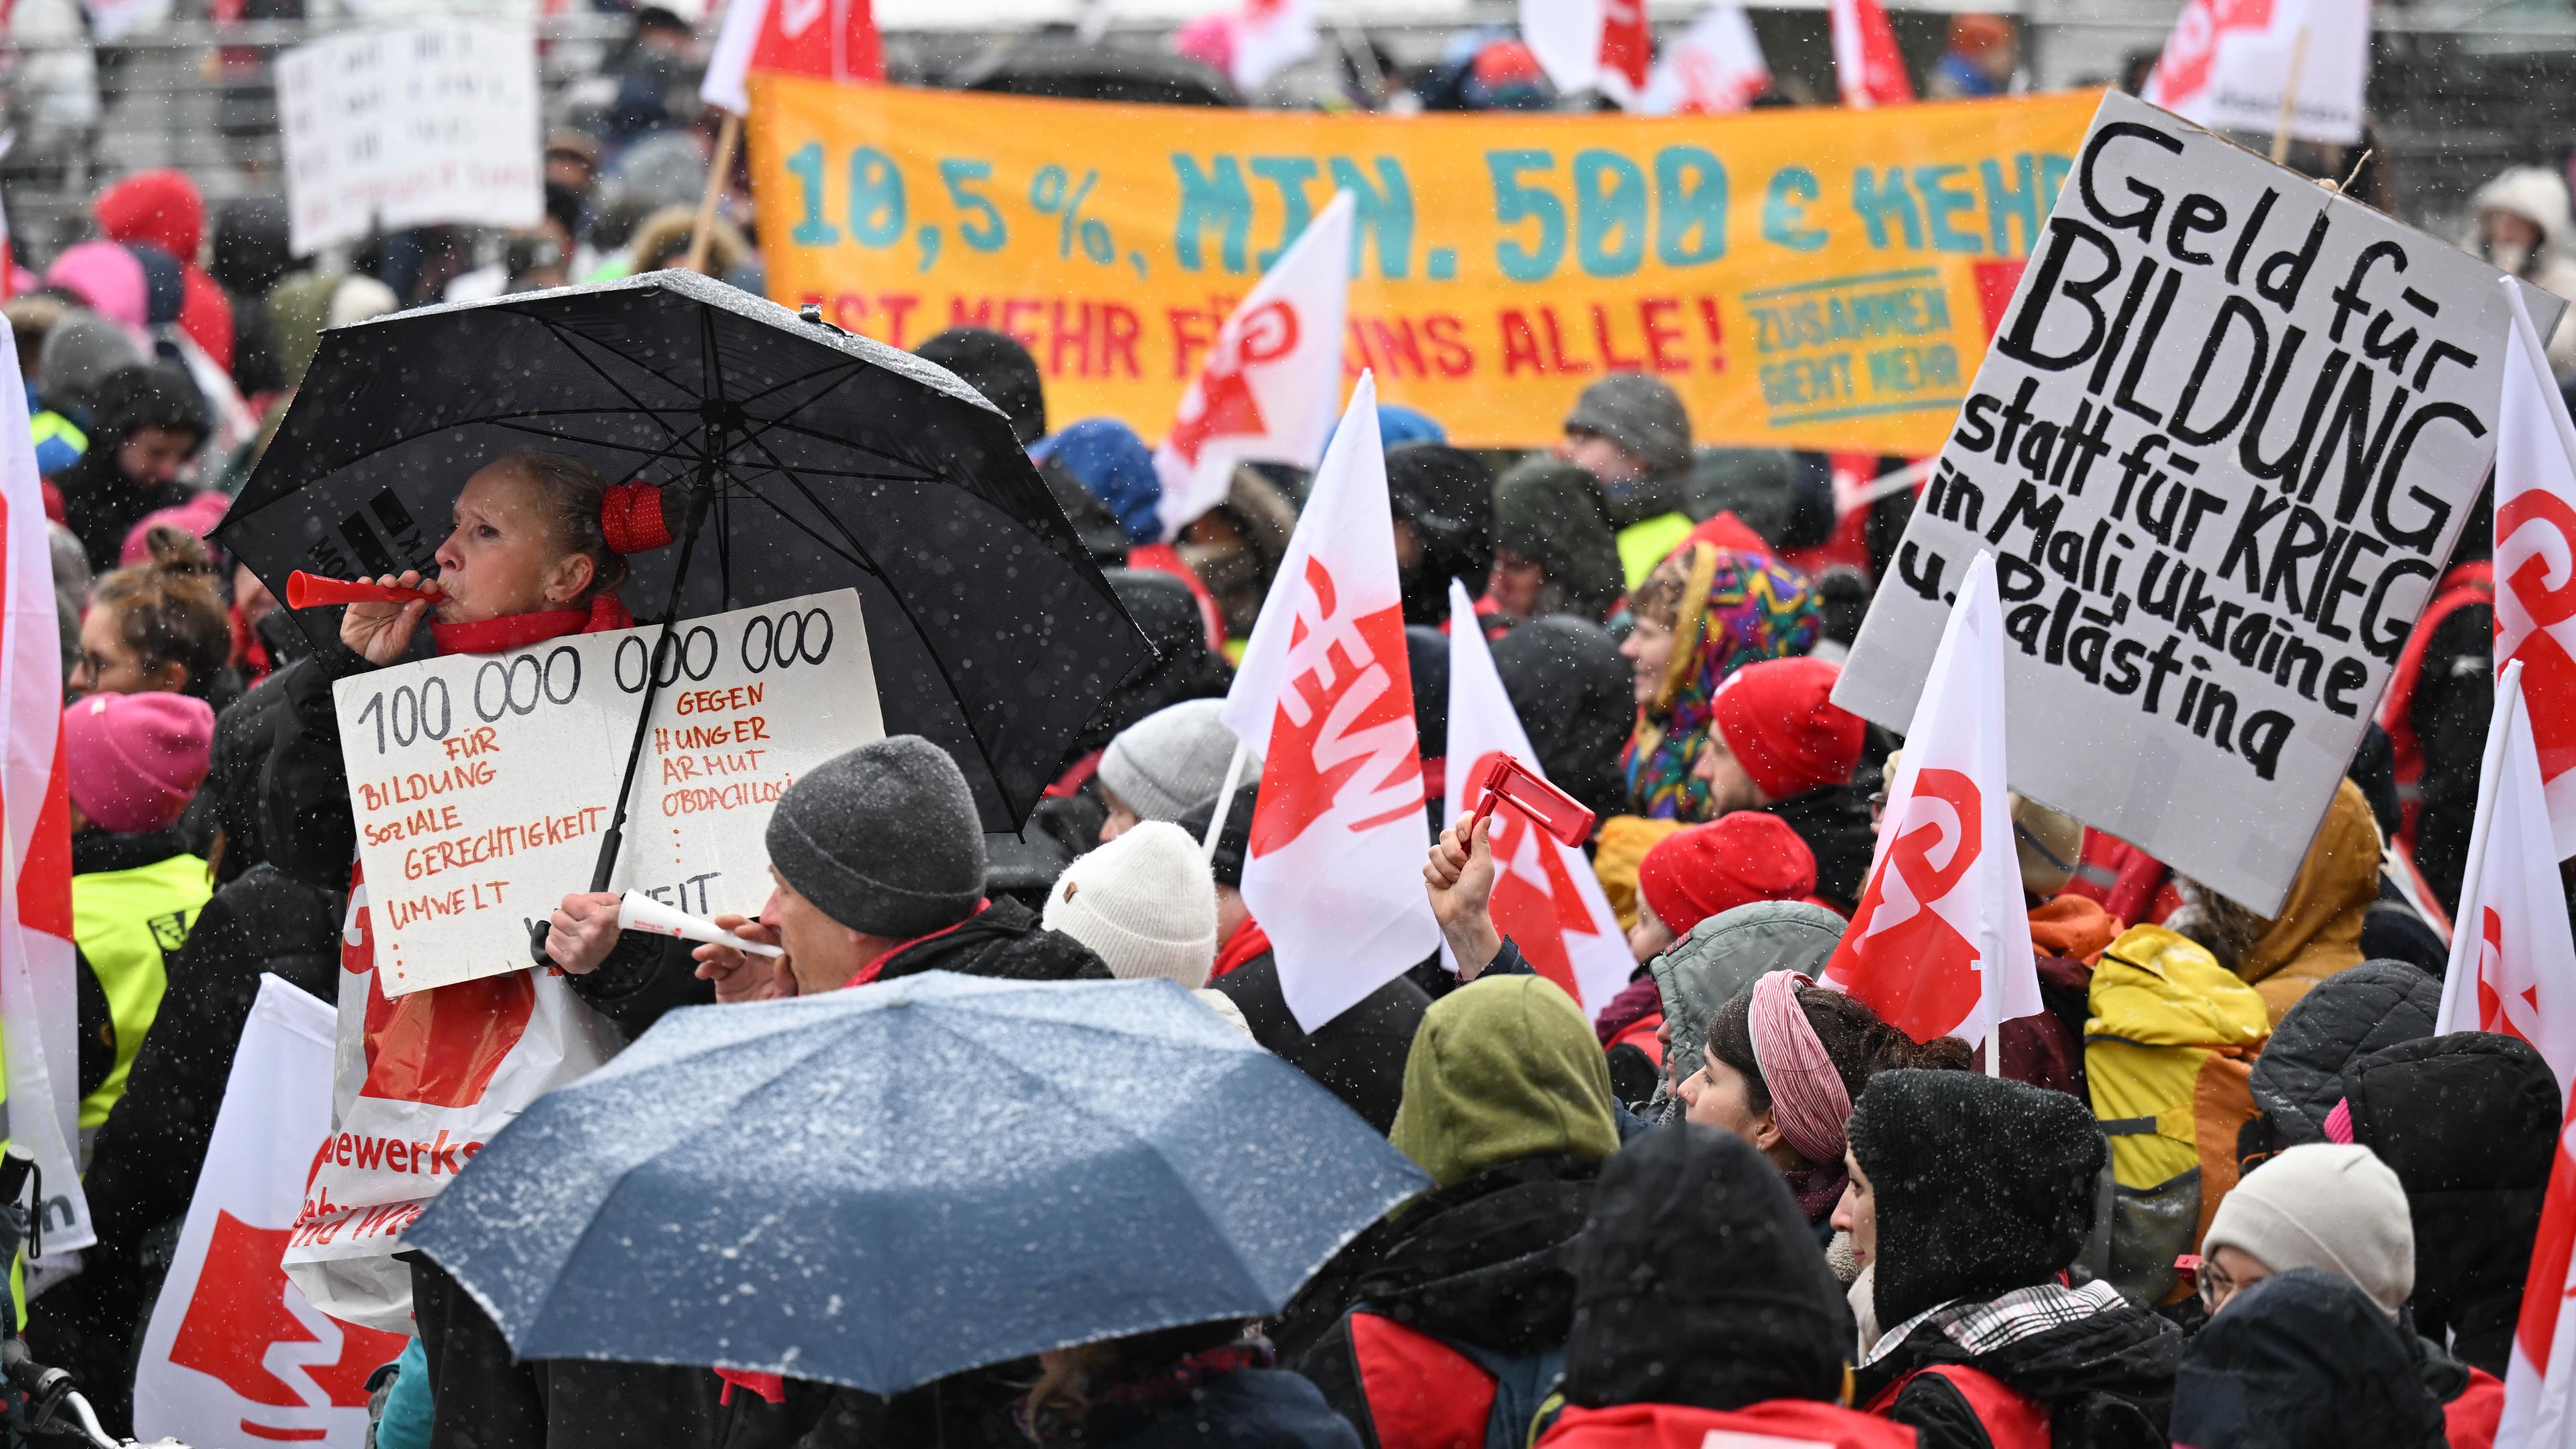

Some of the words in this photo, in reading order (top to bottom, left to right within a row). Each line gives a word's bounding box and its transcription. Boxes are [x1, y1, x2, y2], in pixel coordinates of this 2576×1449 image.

[787, 142, 1007, 272] 10,5
[1169, 152, 1458, 281] MIN.
[1485, 146, 1729, 282] 500
[1760, 165, 1829, 252] €
[2080, 122, 2330, 313] Geld
[2331, 240, 2477, 392] für
[1498, 297, 1727, 378] ALLE!
[1996, 217, 2487, 556] BILDUNG
[1953, 376, 2113, 496] statt
[2110, 434, 2228, 553] für
[2216, 484, 2438, 665] KRIEG
[1926, 456, 1985, 533] in
[2137, 550, 2368, 719] Ukraine
[358, 676, 451, 755] 100
[474, 646, 581, 722] 000
[614, 625, 718, 694] 000
[741, 608, 834, 674] 000
[678, 682, 764, 716] GEGEN
[1995, 551, 2296, 782] Palästina
[443, 727, 500, 761] FÜR
[655, 716, 770, 755] HUNGER
[663, 749, 766, 785] ARMUT
[358, 761, 496, 810] BILDUNG
[405, 806, 607, 880] GERECHTIGKEIT
[387, 881, 510, 930] UMWELT
